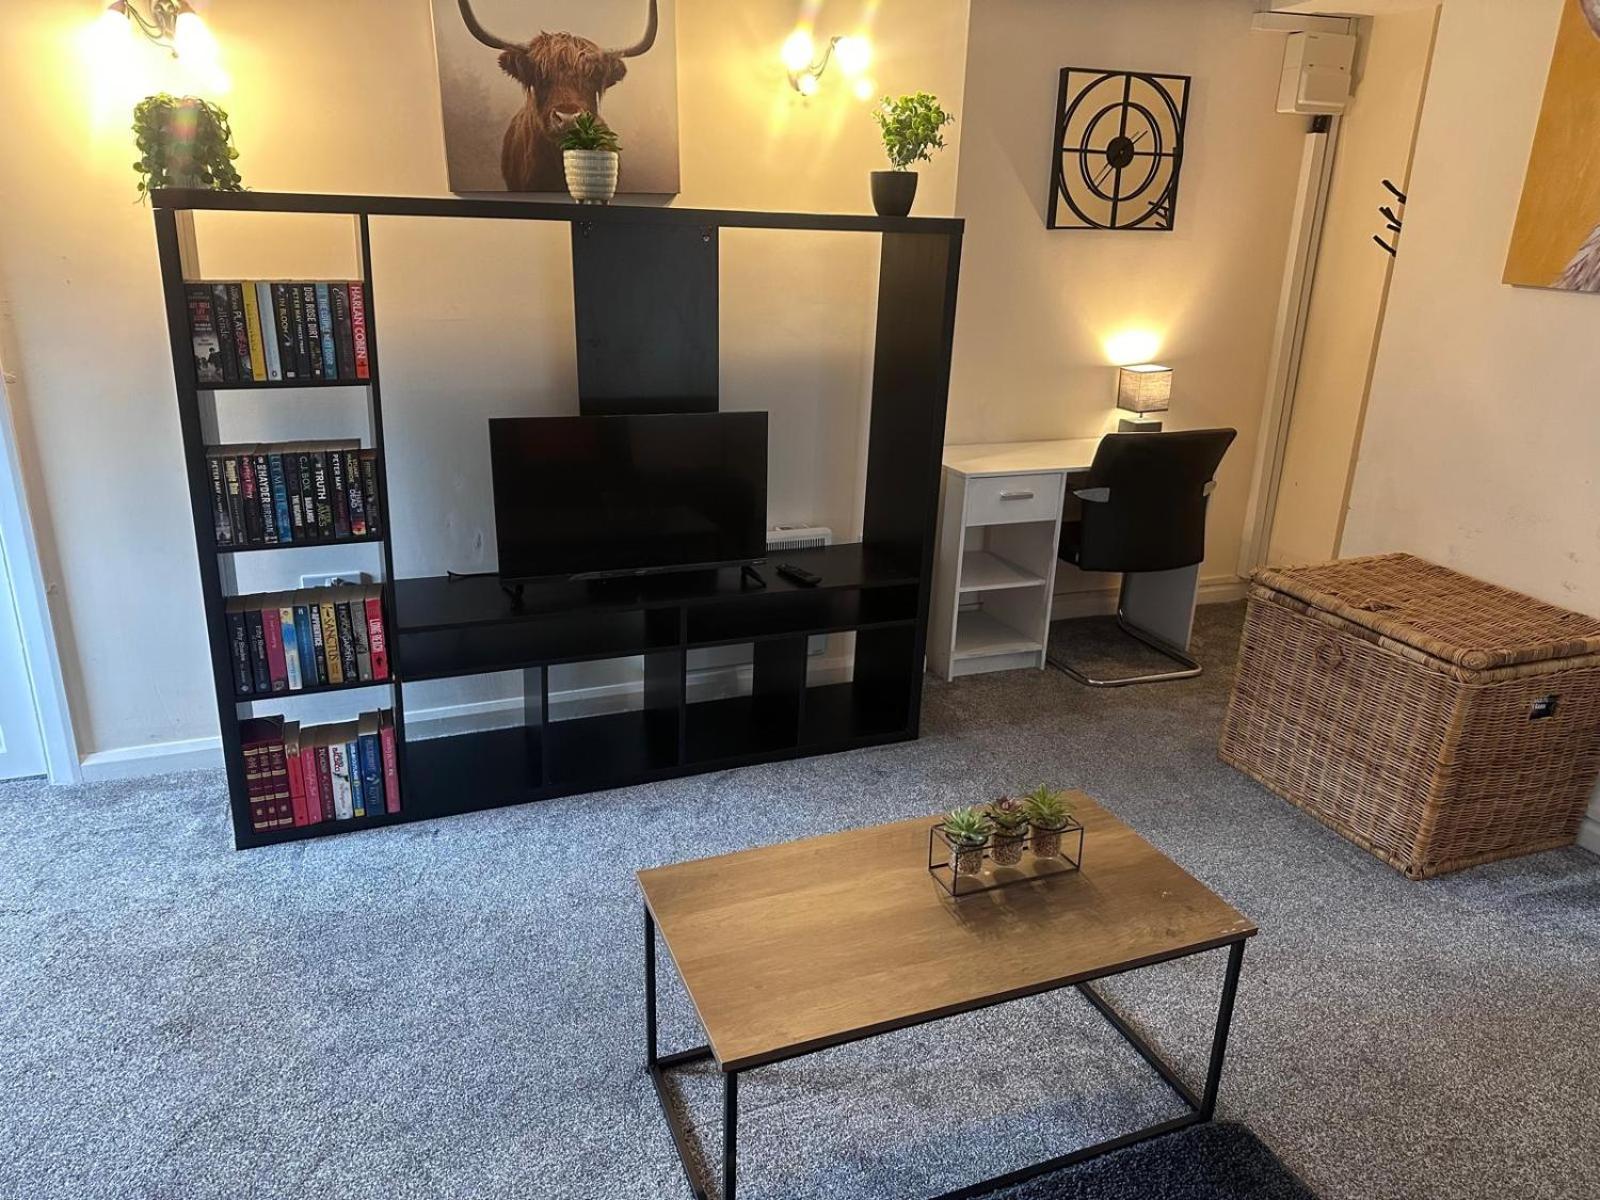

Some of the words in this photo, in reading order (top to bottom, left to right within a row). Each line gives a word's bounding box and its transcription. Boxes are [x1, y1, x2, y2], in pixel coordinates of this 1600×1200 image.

[303, 287, 314, 302] DOG
[350, 286, 363, 325] HARLAN
[305, 303, 316, 322] ROSE
[307, 323, 319, 339] DIRT
[354, 326, 366, 359] COBEN
[211, 459, 221, 480] PETER
[332, 453, 340, 476] PETER
[257, 470, 271, 503] HAYDER
[315, 469, 327, 500] TRUTH
[324, 617, 339, 662] SANCTUS
